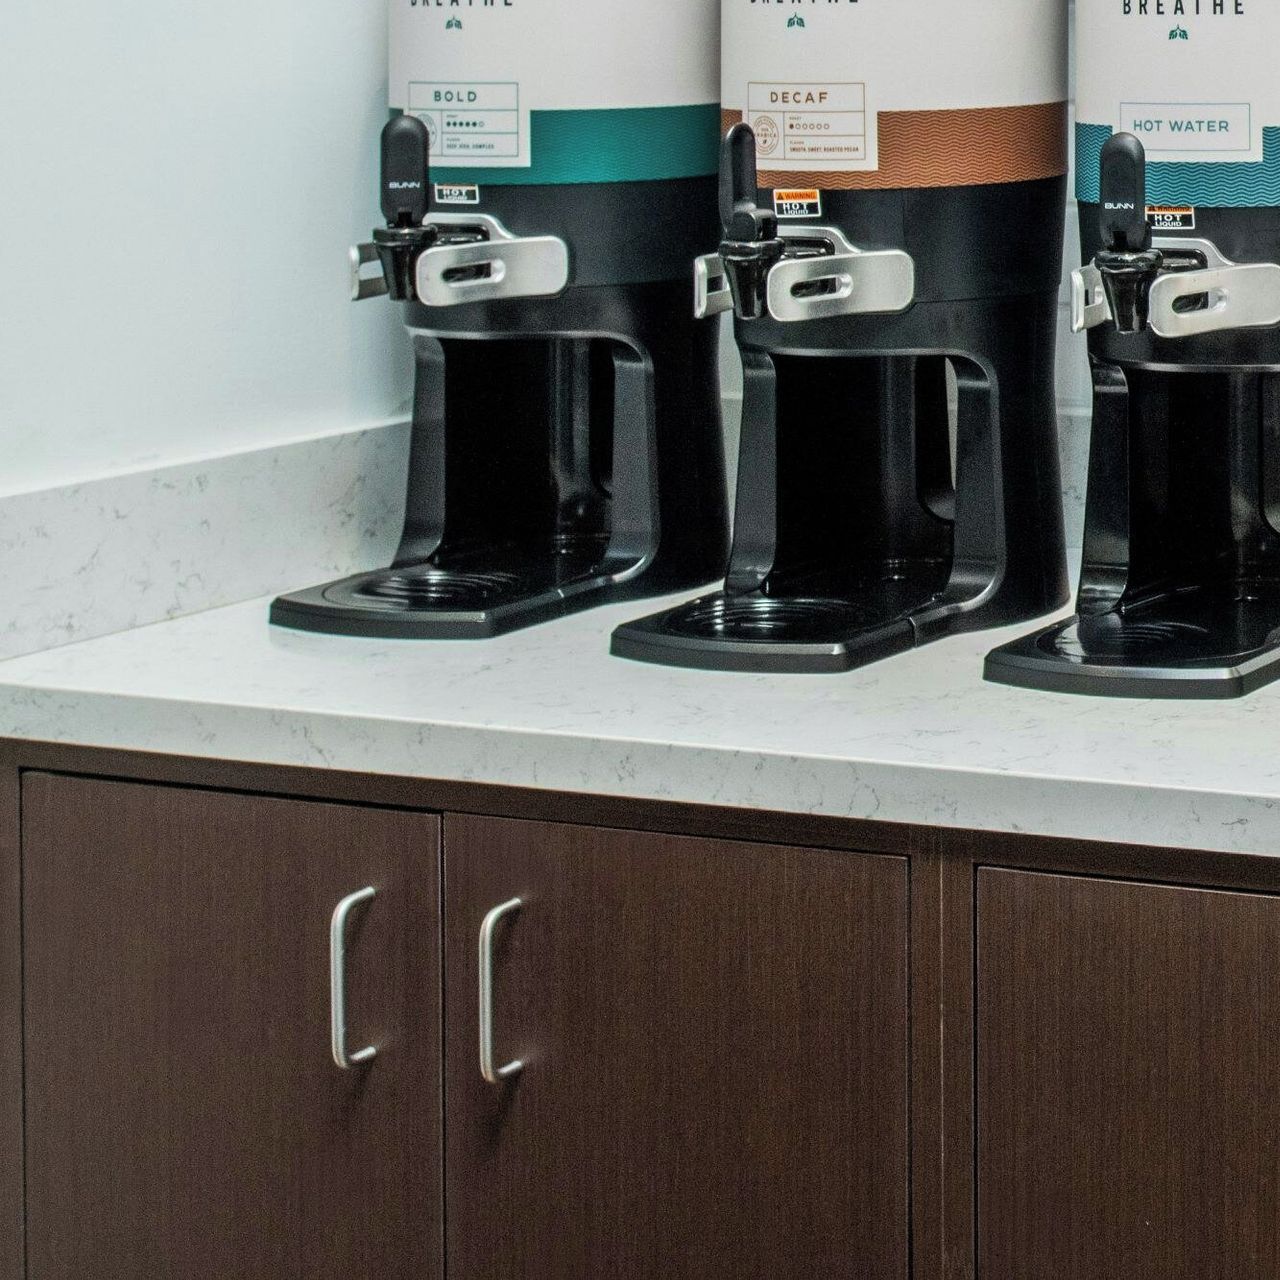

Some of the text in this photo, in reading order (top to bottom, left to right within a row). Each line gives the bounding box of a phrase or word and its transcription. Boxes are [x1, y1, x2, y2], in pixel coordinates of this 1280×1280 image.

[434, 90, 477, 102] BOLD
[770, 91, 828, 103] DECAF
[1133, 119, 1230, 133] HOT WATER
[389, 181, 420, 189] BUNN
[784, 192, 817, 200] WARNING
[782, 202, 808, 210] HOT
[1104, 202, 1135, 210] BUNN
